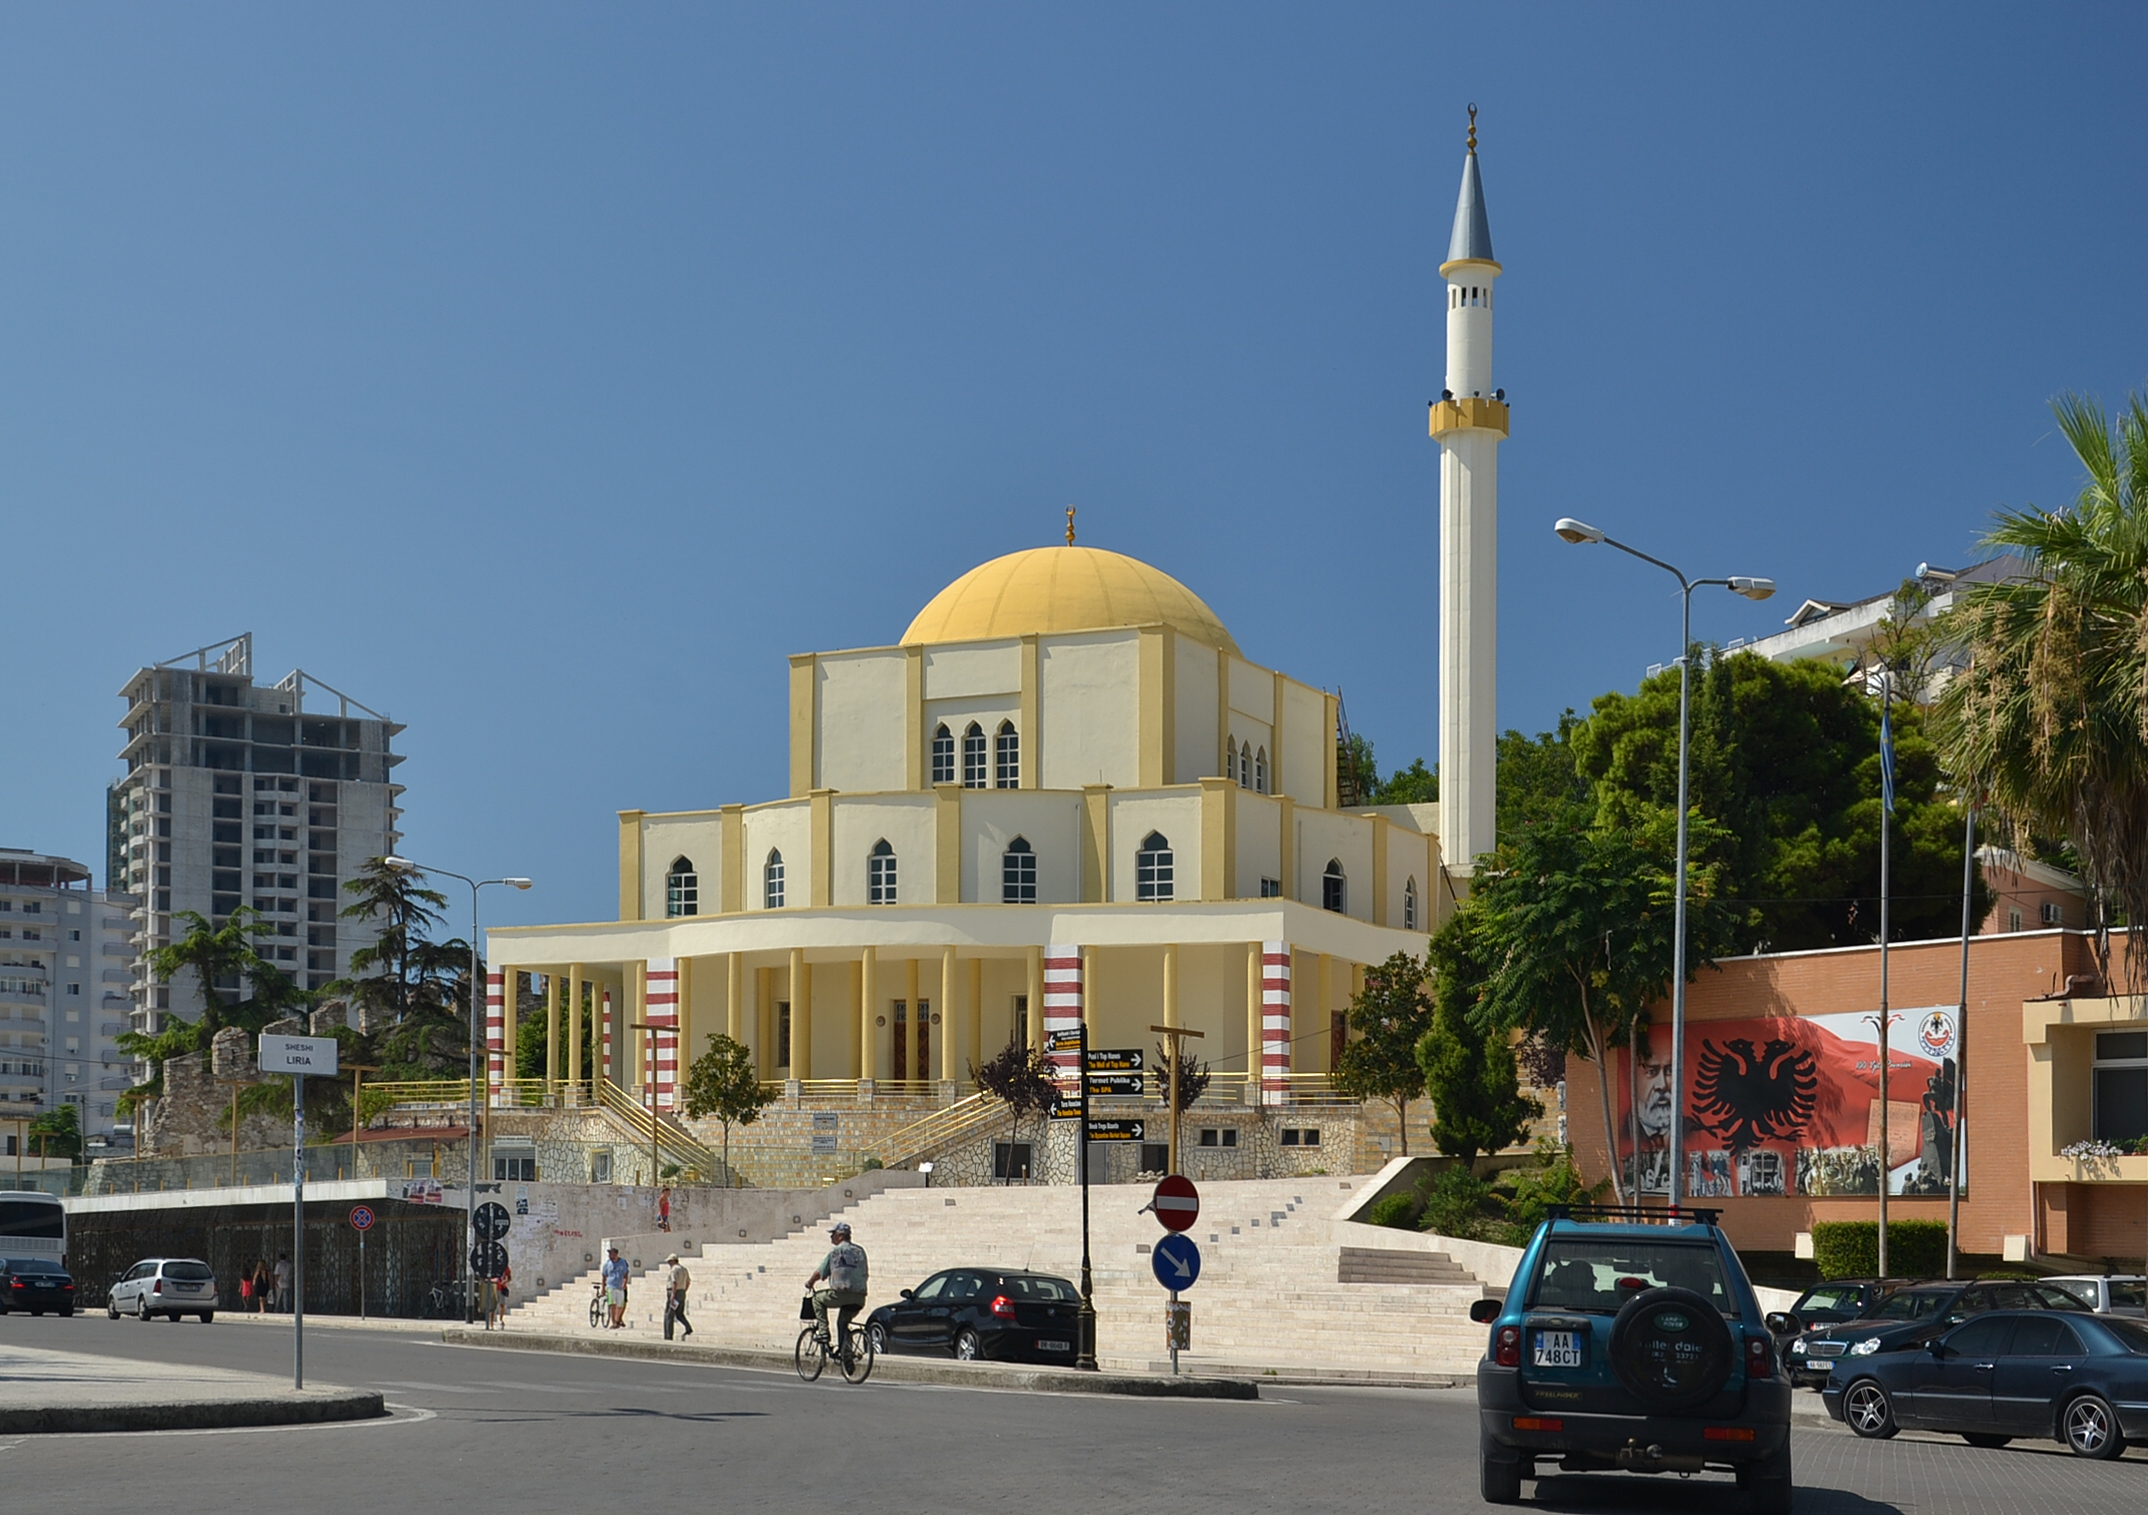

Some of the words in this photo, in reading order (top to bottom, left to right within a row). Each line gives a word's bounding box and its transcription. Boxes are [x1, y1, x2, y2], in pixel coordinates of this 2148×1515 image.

[285, 1043, 314, 1052] SHESHI
[286, 1056, 312, 1065] LIRIA
[1088, 1061, 1096, 1069] The
[1553, 1333, 1569, 1349] AA
[1536, 1349, 1579, 1365] 748CT
